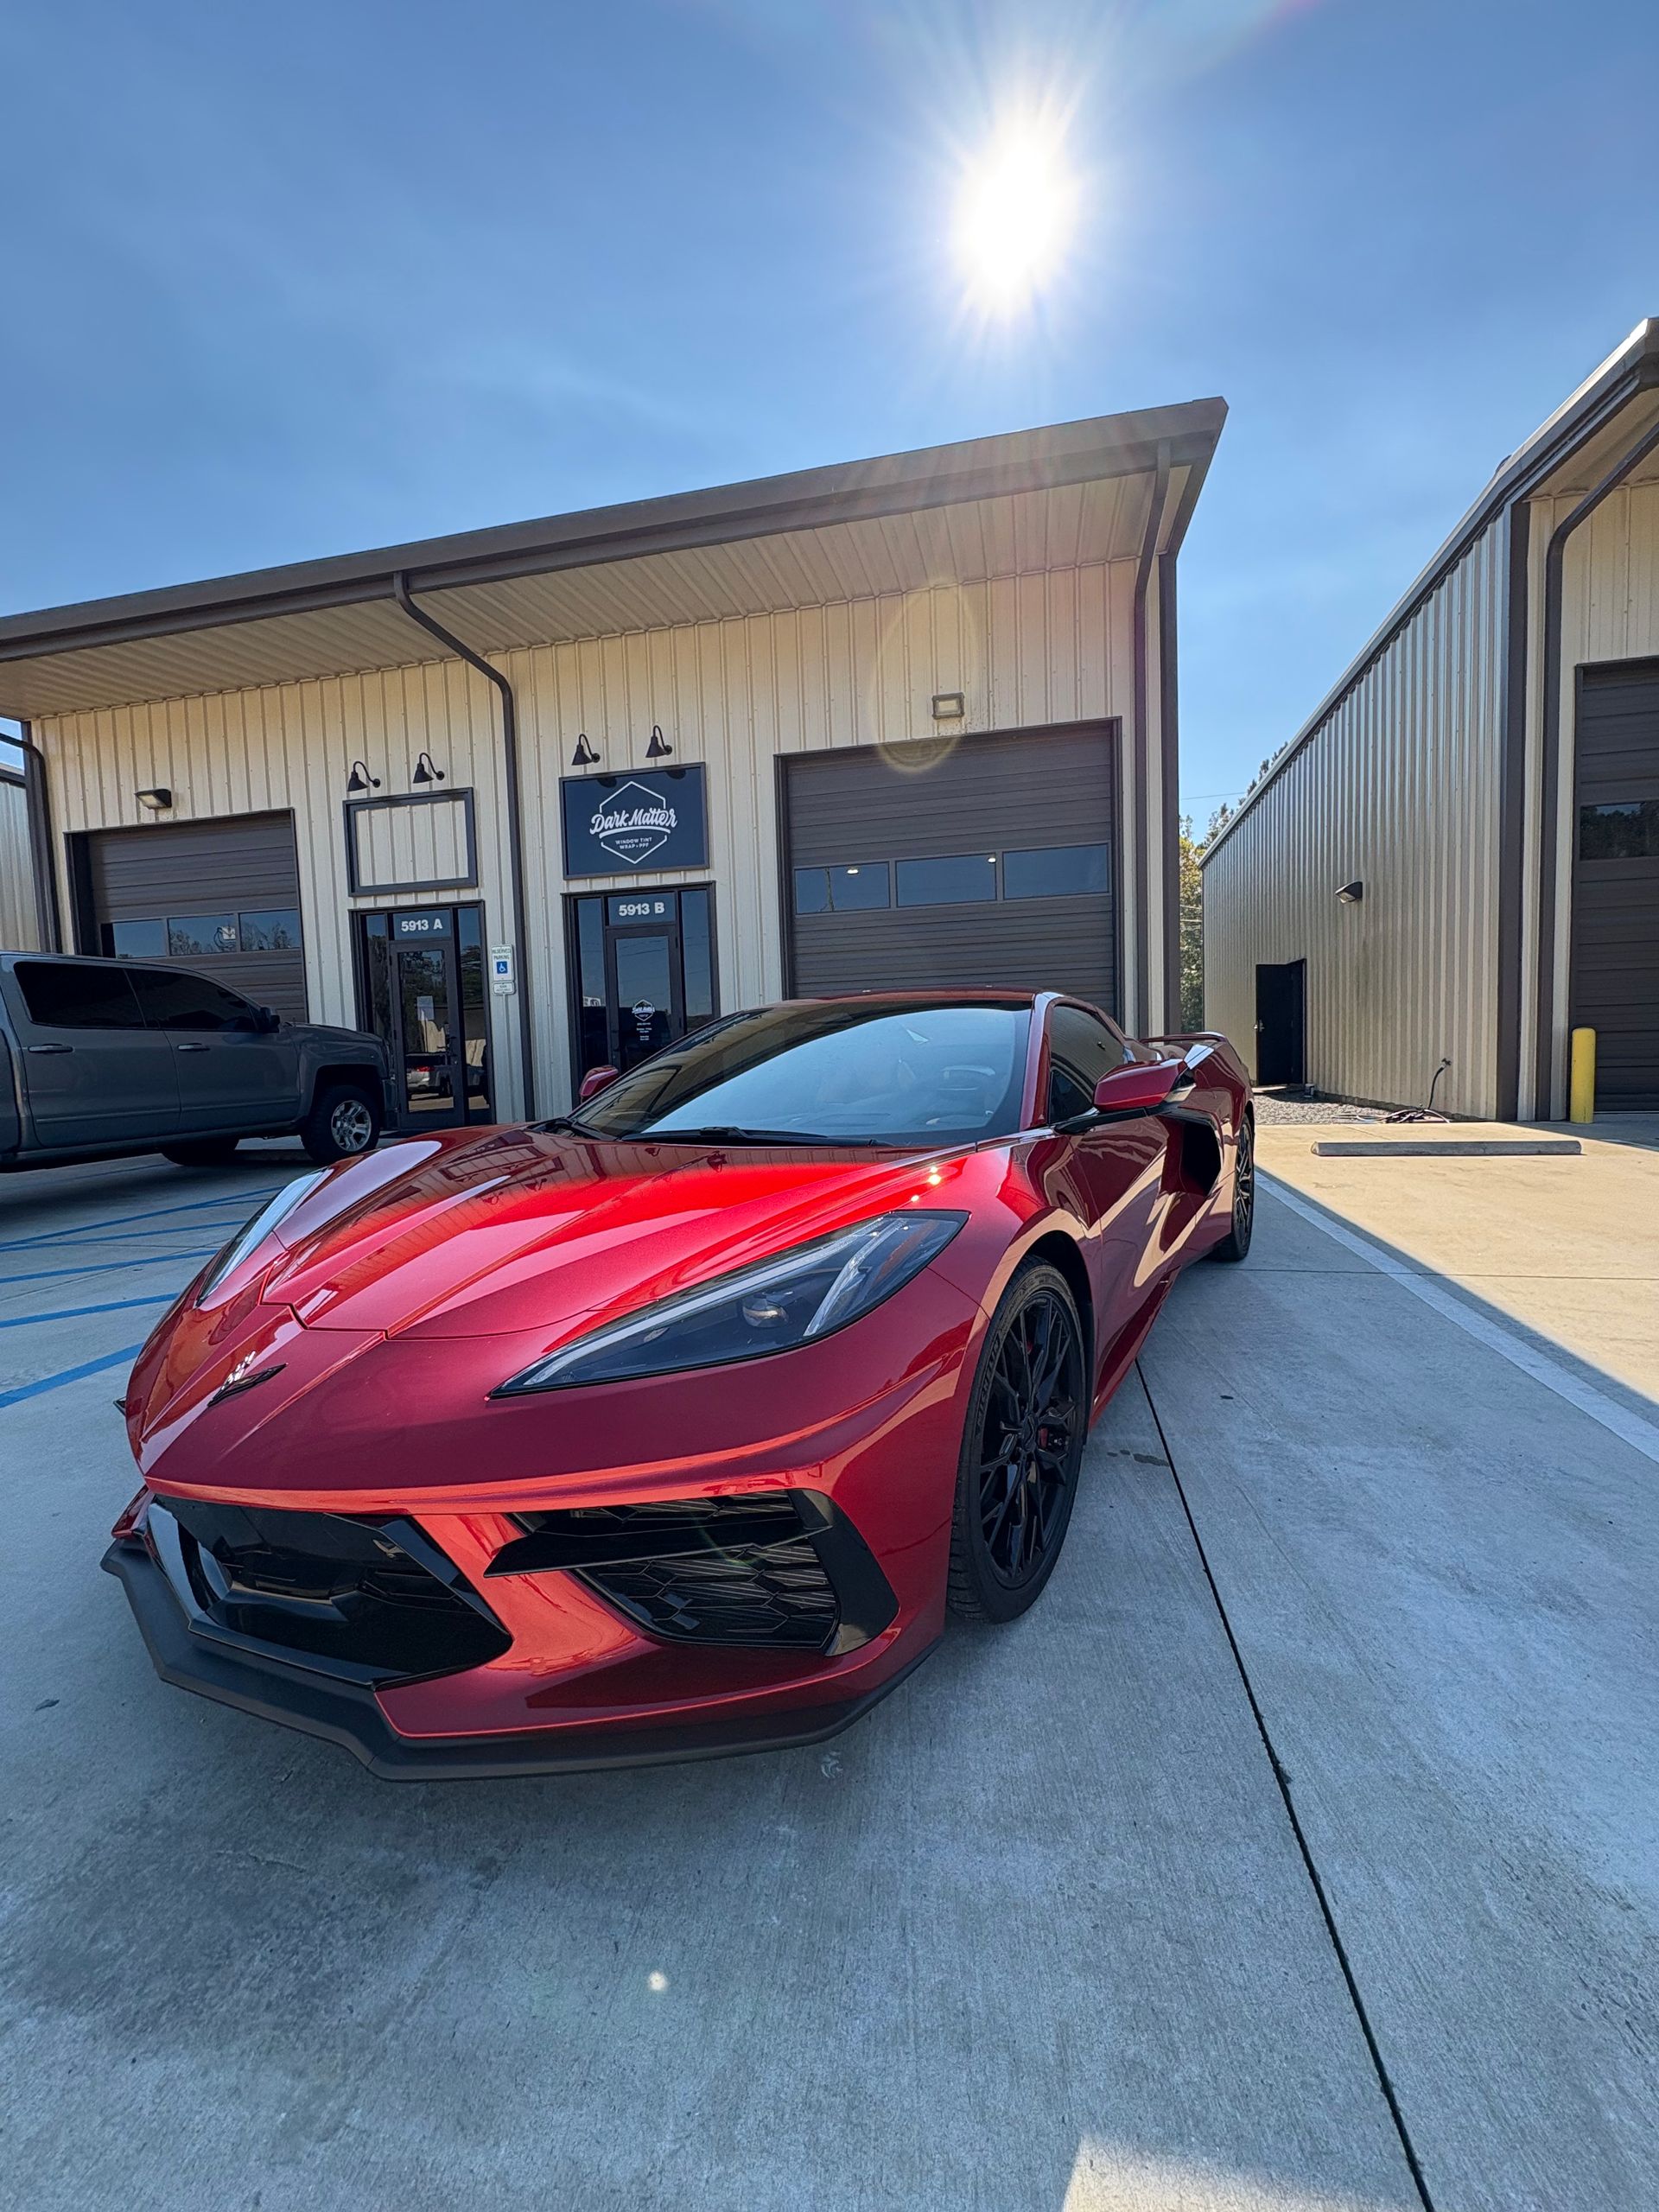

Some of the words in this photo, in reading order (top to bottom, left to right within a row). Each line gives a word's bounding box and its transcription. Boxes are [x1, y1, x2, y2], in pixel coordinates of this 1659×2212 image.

[589, 810, 629, 835] Dark
[628, 807, 678, 828] Matter
[619, 902, 650, 917] 5913
[654, 901, 665, 914] B
[401, 919, 429, 931] 5913
[433, 918, 443, 930] A
